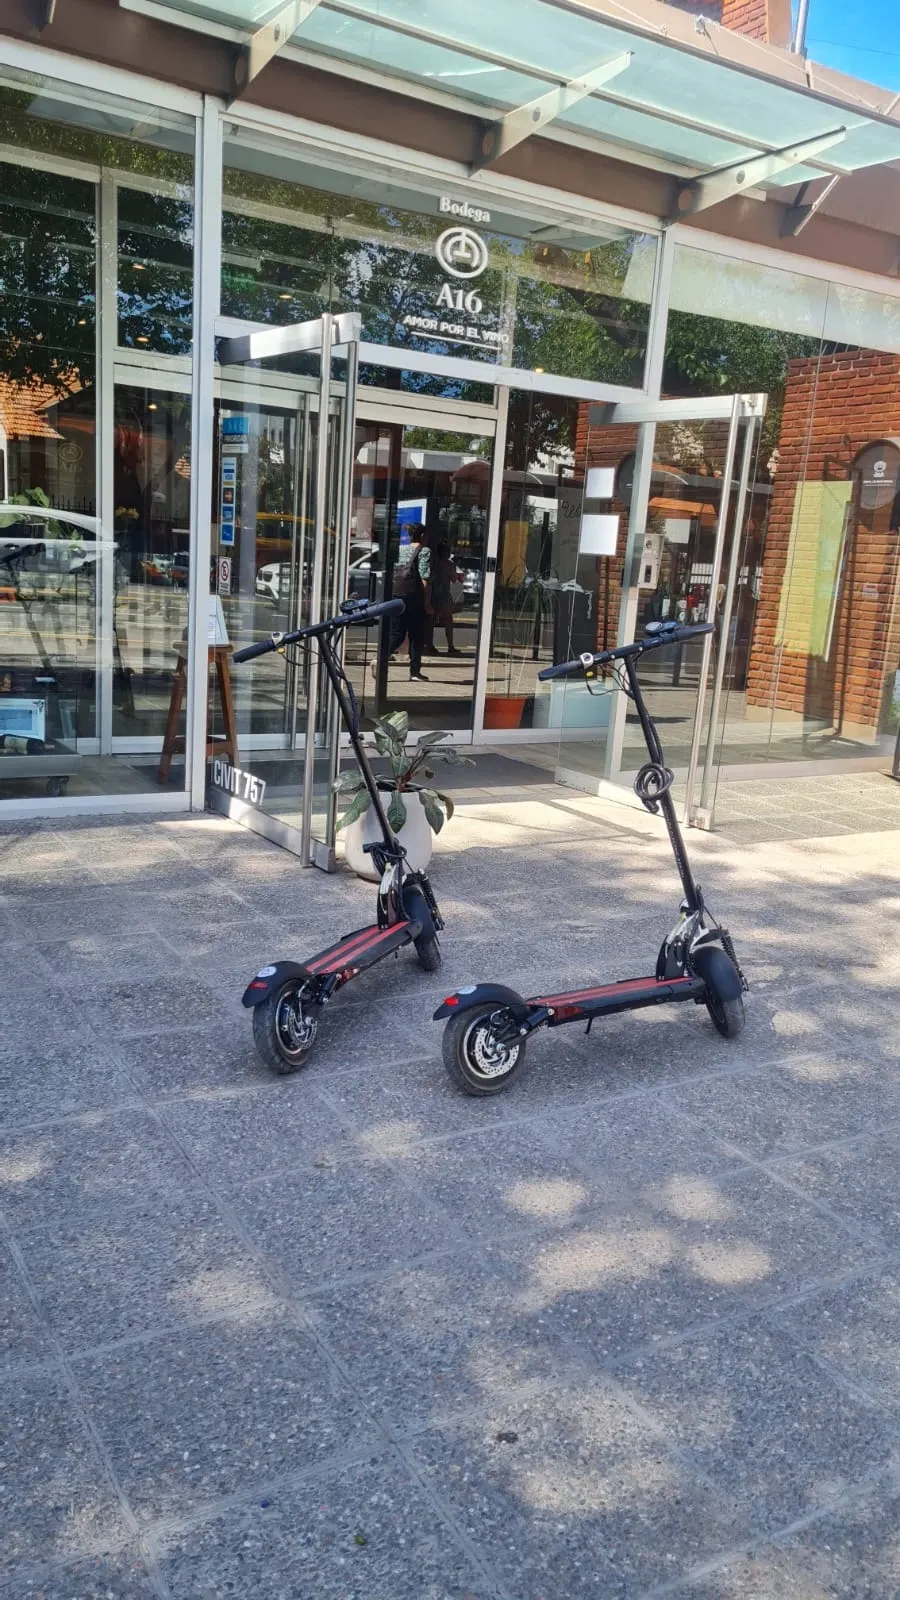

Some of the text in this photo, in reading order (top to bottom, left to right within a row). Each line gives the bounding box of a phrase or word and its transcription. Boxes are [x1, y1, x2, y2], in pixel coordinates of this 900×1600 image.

[439, 197, 491, 223] Bodega
[435, 283, 482, 313] A16
[403, 315, 509, 343] AMOR POR EL VINO
[214, 760, 267, 806] CIVIT 757
